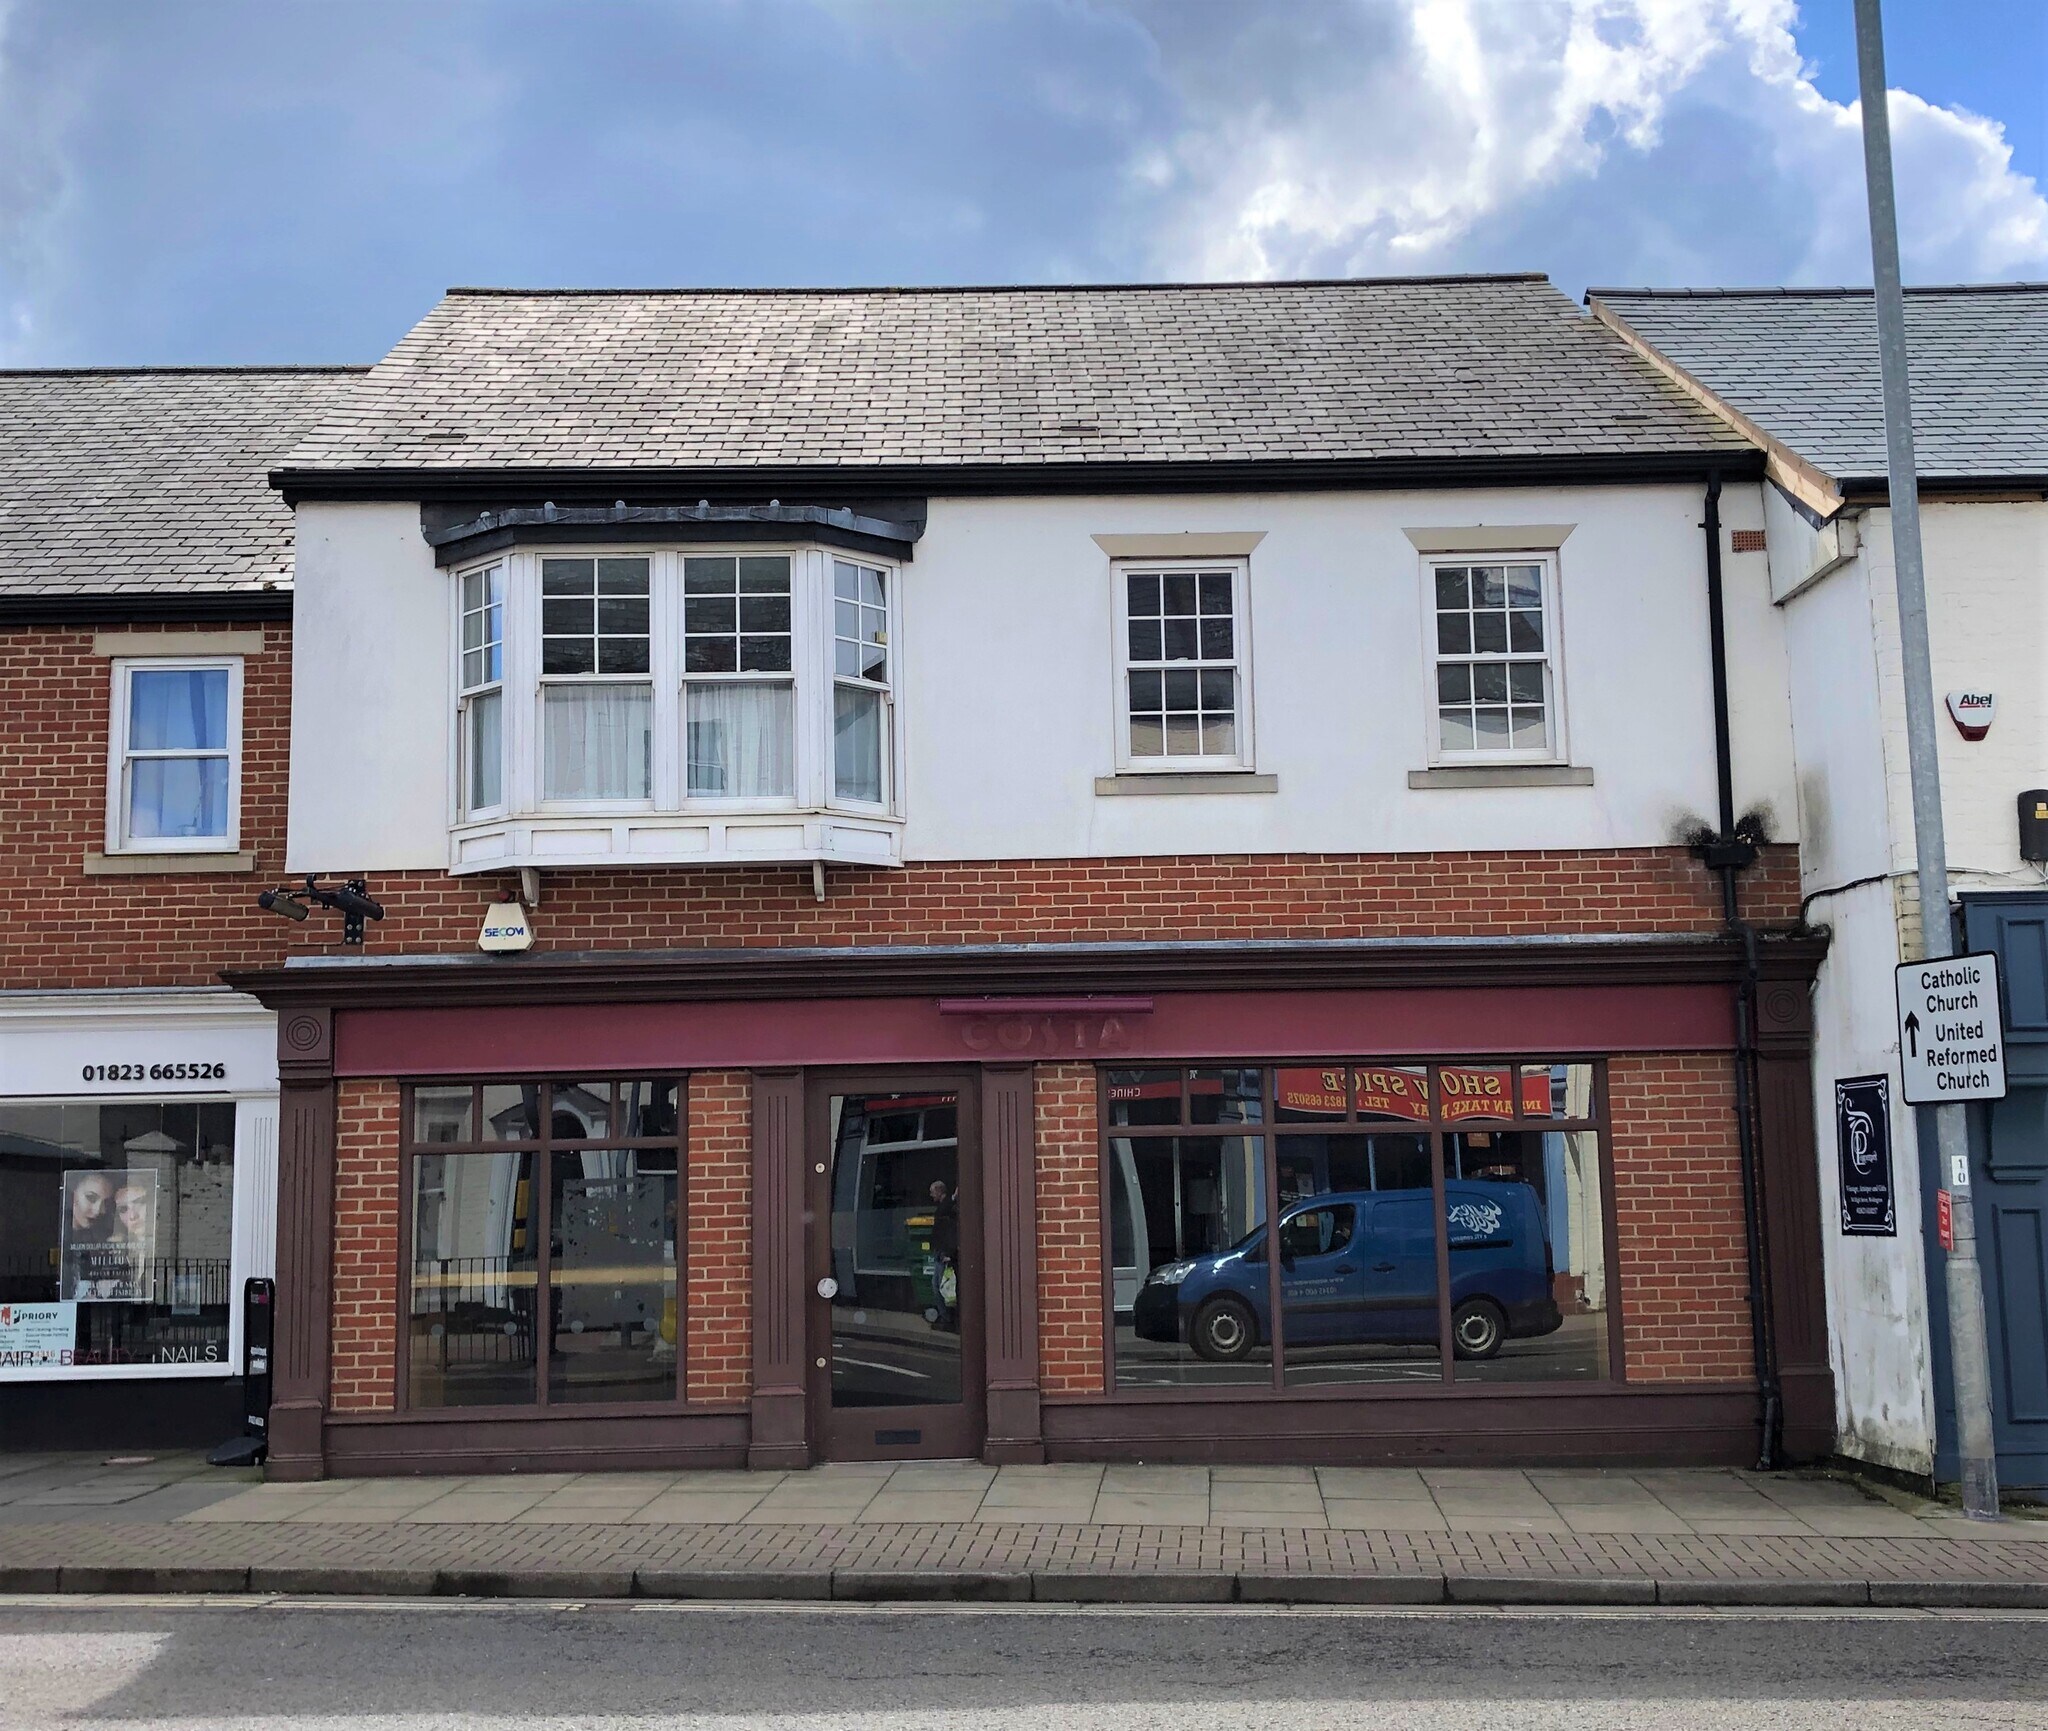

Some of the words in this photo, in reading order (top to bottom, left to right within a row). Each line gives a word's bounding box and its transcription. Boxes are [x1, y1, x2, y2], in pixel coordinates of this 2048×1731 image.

[1960, 694, 1992, 705] Abel
[484, 927, 524, 937] SECOM
[1921, 967, 1981, 990] Catholic
[1926, 991, 1979, 1013] Church
[962, 1016, 1131, 1051] COSTA
[1935, 1020, 1984, 1042] United
[1927, 1044, 1998, 1067] Reformed
[82, 1064, 145, 1081] 01823
[149, 1062, 226, 1080] 665526
[1937, 1070, 1990, 1090] Church
[22, 1312, 58, 1320] PRIORY
[161, 1346, 218, 1363] NAILS
